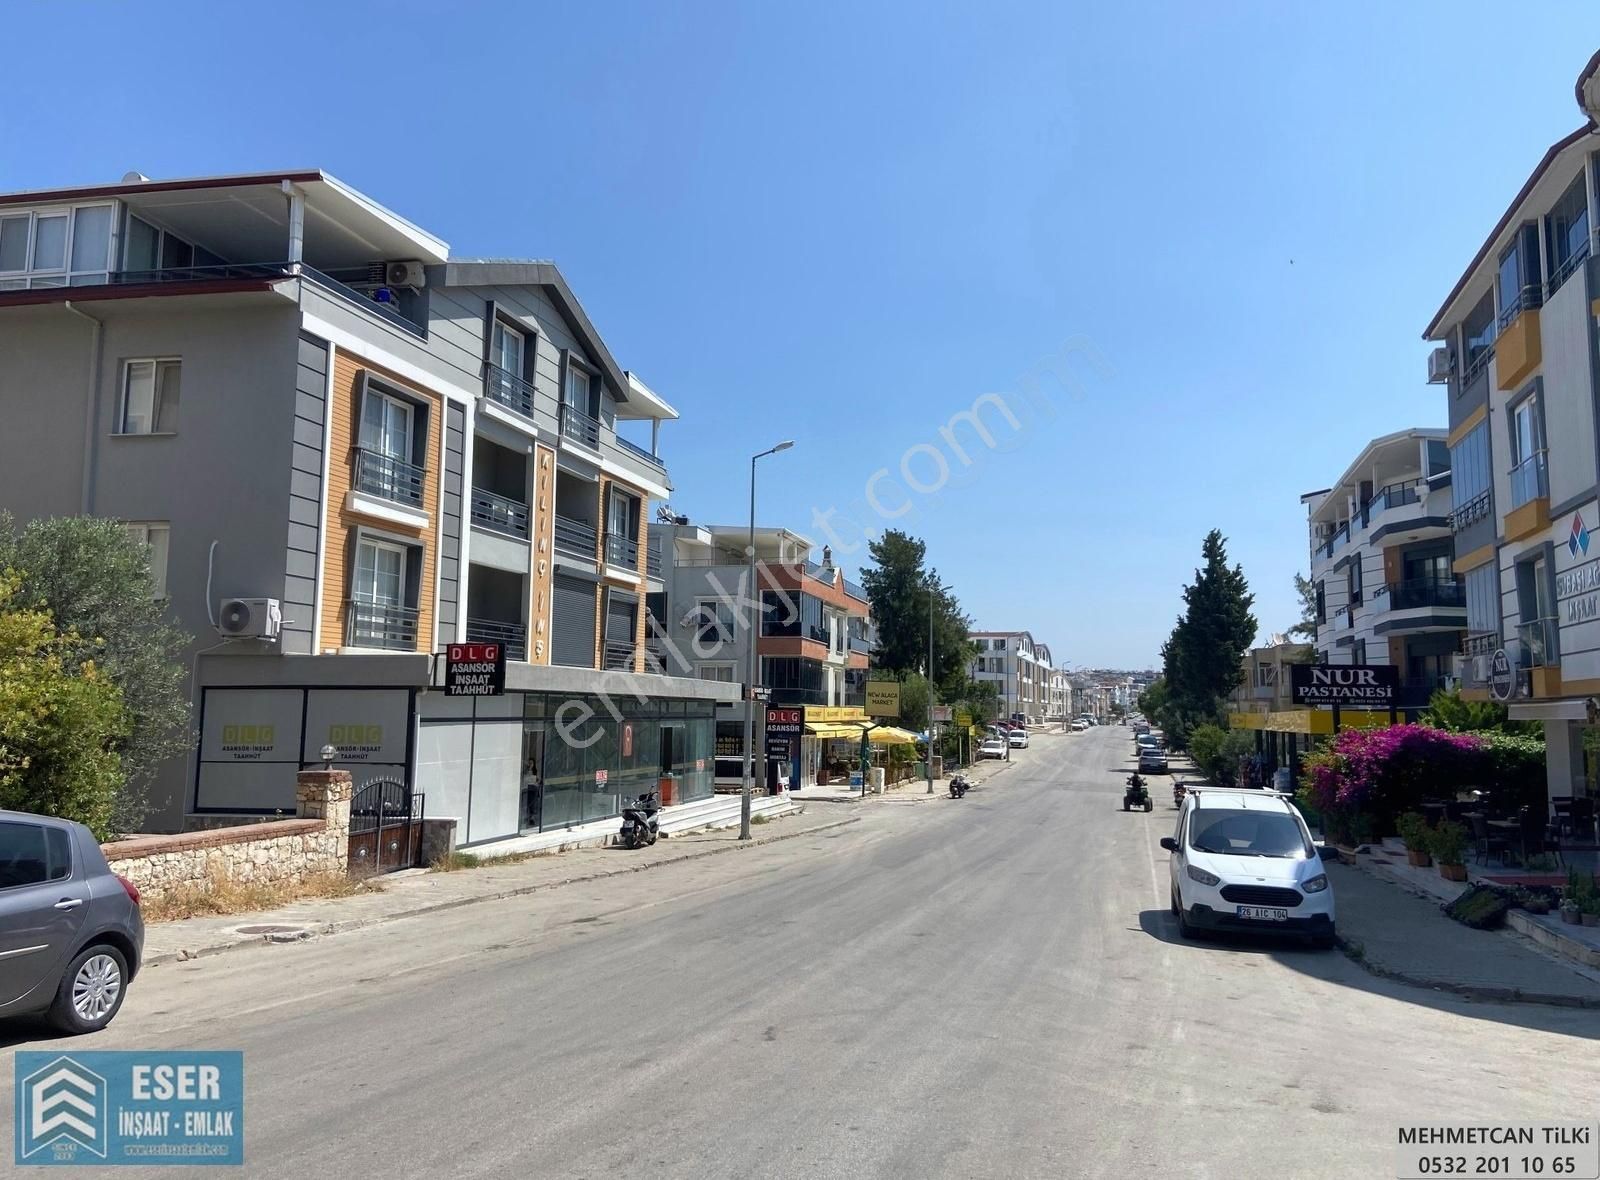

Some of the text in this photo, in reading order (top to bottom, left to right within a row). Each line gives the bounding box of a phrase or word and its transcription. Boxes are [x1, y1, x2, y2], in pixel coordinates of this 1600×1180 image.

[452, 647, 495, 660] DLG
[451, 662, 496, 673] ASANSÖR
[455, 673, 491, 686] İNŞAAT
[1311, 669, 1380, 685] NUR
[450, 684, 495, 695] TAAHHÜT
[1298, 685, 1393, 697] PASTANESİ
[769, 711, 799, 721] DLG
[767, 723, 800, 732] ASANSÖR
[226, 726, 273, 743] DLG
[331, 726, 379, 743] DLG
[1255, 909, 1269, 918] AIC
[1273, 910, 1287, 919] 104
